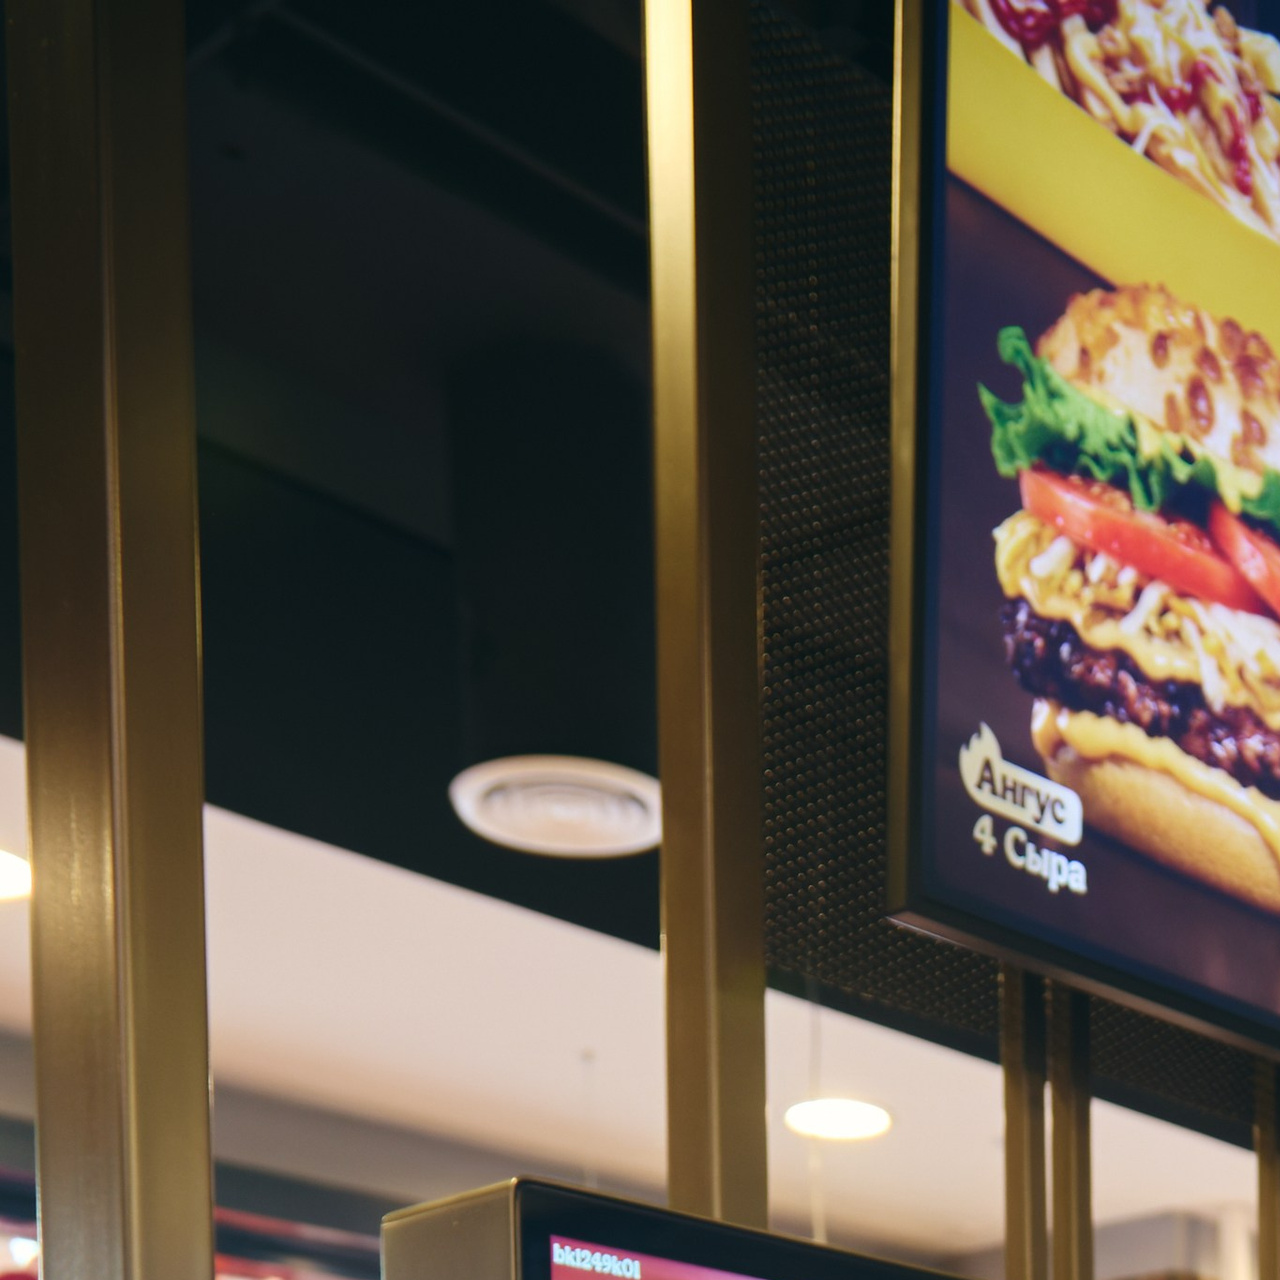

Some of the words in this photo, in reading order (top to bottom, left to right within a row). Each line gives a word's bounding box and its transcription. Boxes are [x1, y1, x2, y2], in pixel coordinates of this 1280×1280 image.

[975, 757, 1065, 824] Ангус
[973, 814, 998, 856] 4
[1004, 826, 1088, 895] Сыра
